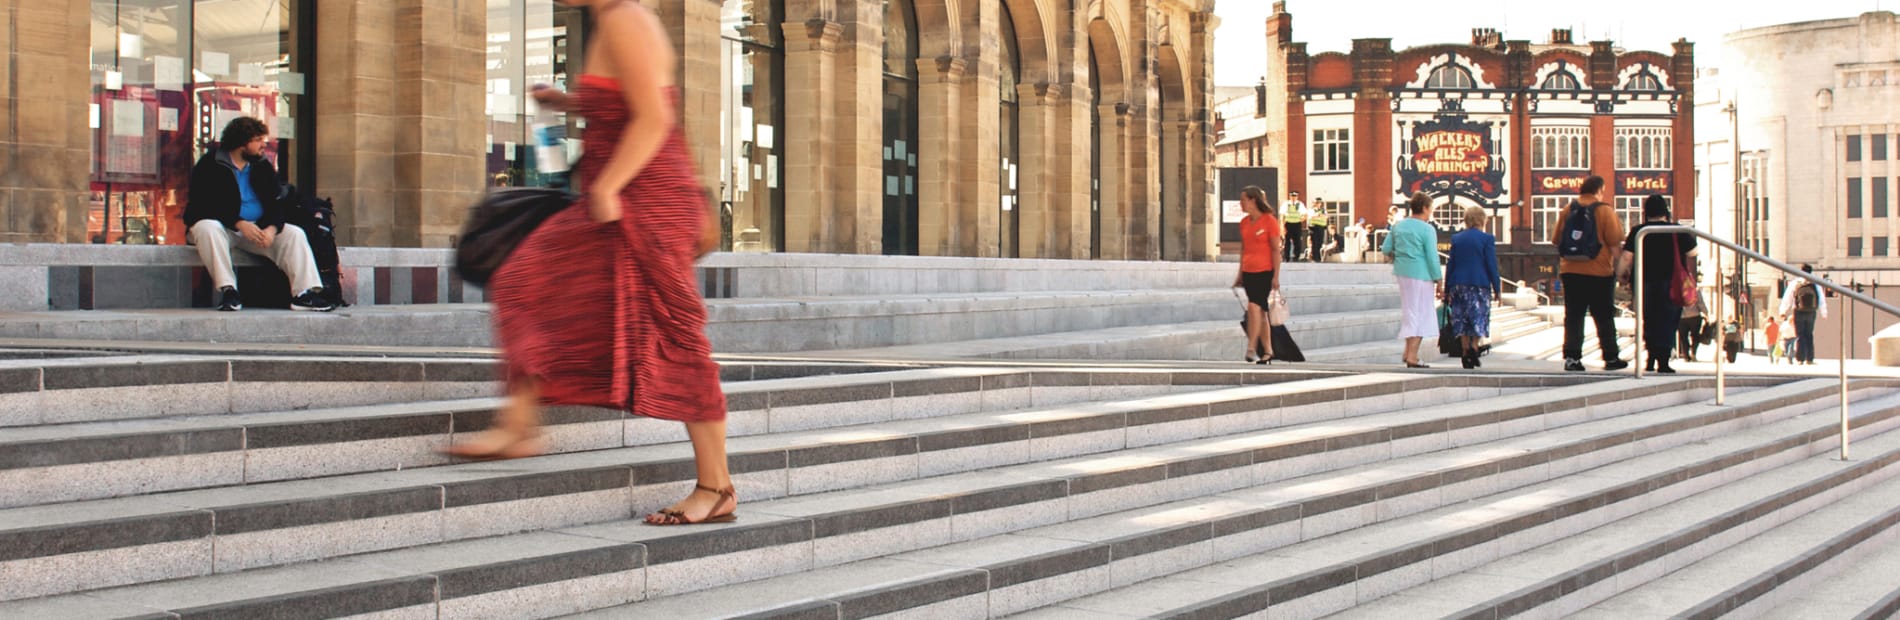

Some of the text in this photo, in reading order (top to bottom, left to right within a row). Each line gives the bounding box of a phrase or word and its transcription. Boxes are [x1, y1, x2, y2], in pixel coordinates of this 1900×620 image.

[1434, 147, 1470, 161] ALES
[1543, 176, 1667, 190] CROWN HOTEL
